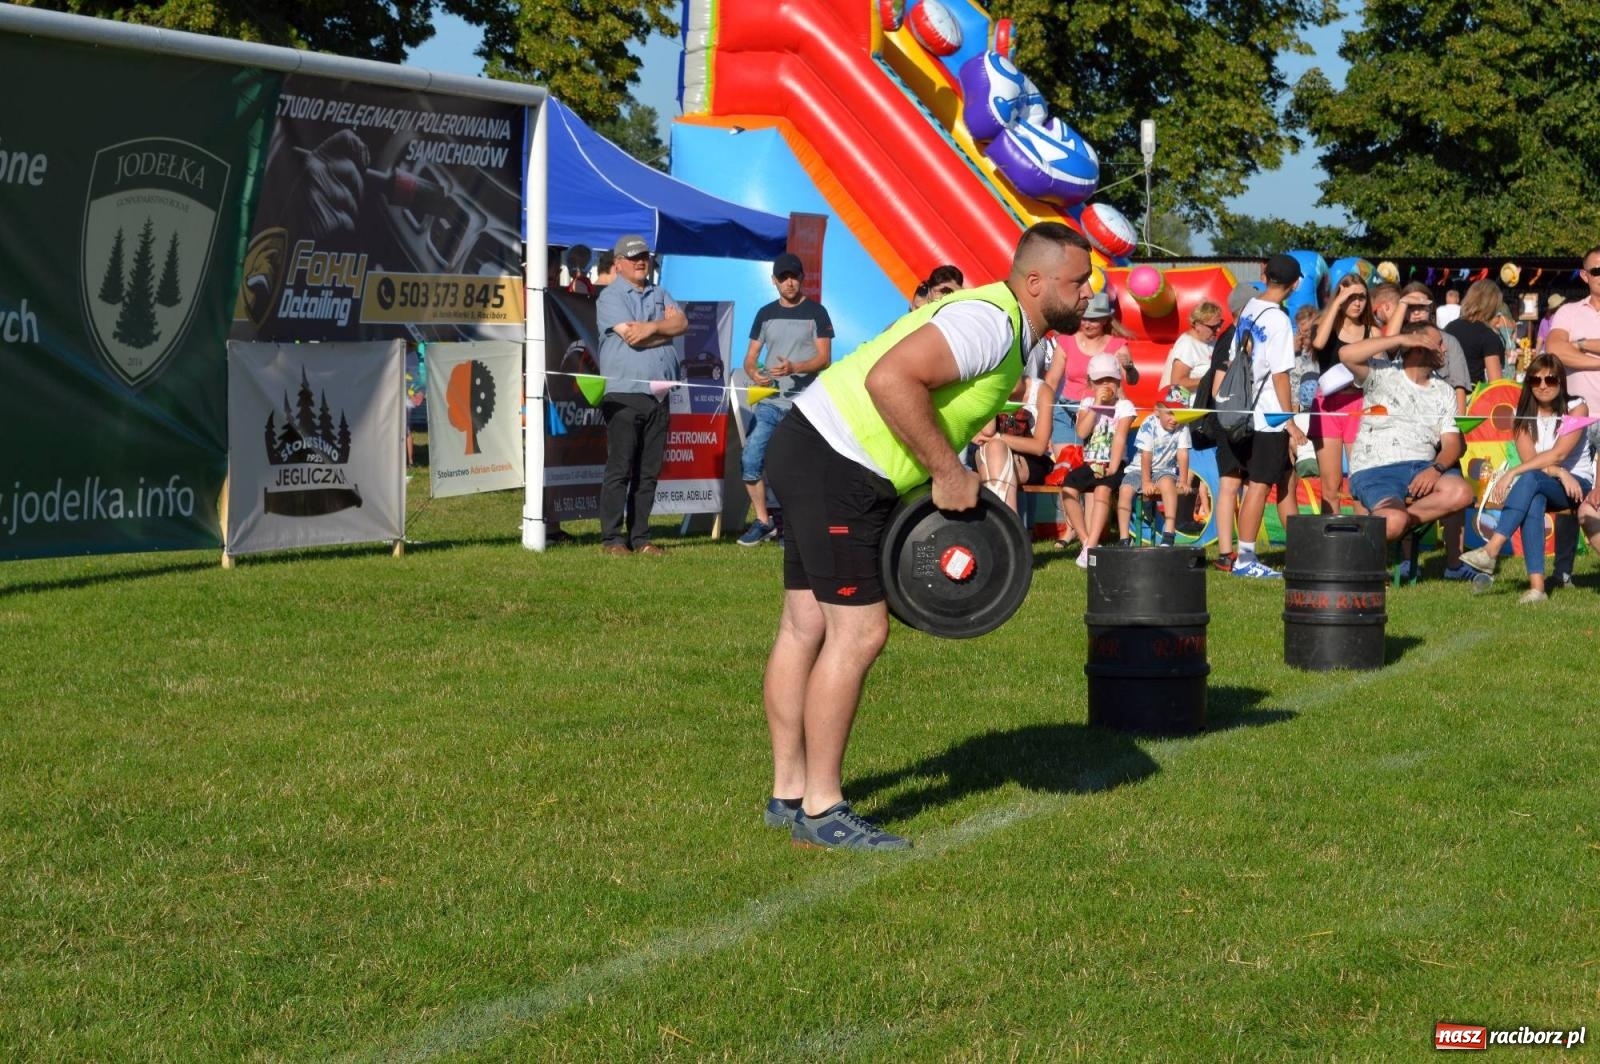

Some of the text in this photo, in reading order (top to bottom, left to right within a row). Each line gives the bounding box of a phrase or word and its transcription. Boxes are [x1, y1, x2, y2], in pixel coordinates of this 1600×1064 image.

[322, 101, 411, 135] PIELĘGNACJI
[414, 114, 511, 141] POLEROWANIA
[406, 140, 509, 169] SAMOCHODÓW
[114, 152, 208, 190] JODEŁKA
[277, 288, 352, 327] Detailing
[399, 280, 506, 309] 503 573 845
[666, 431, 718, 445] LEKTRONIKA
[437, 467, 470, 480] Stolarstwo
[0, 475, 195, 536] .jodelka.info
[686, 489, 713, 502] ADBLUE
